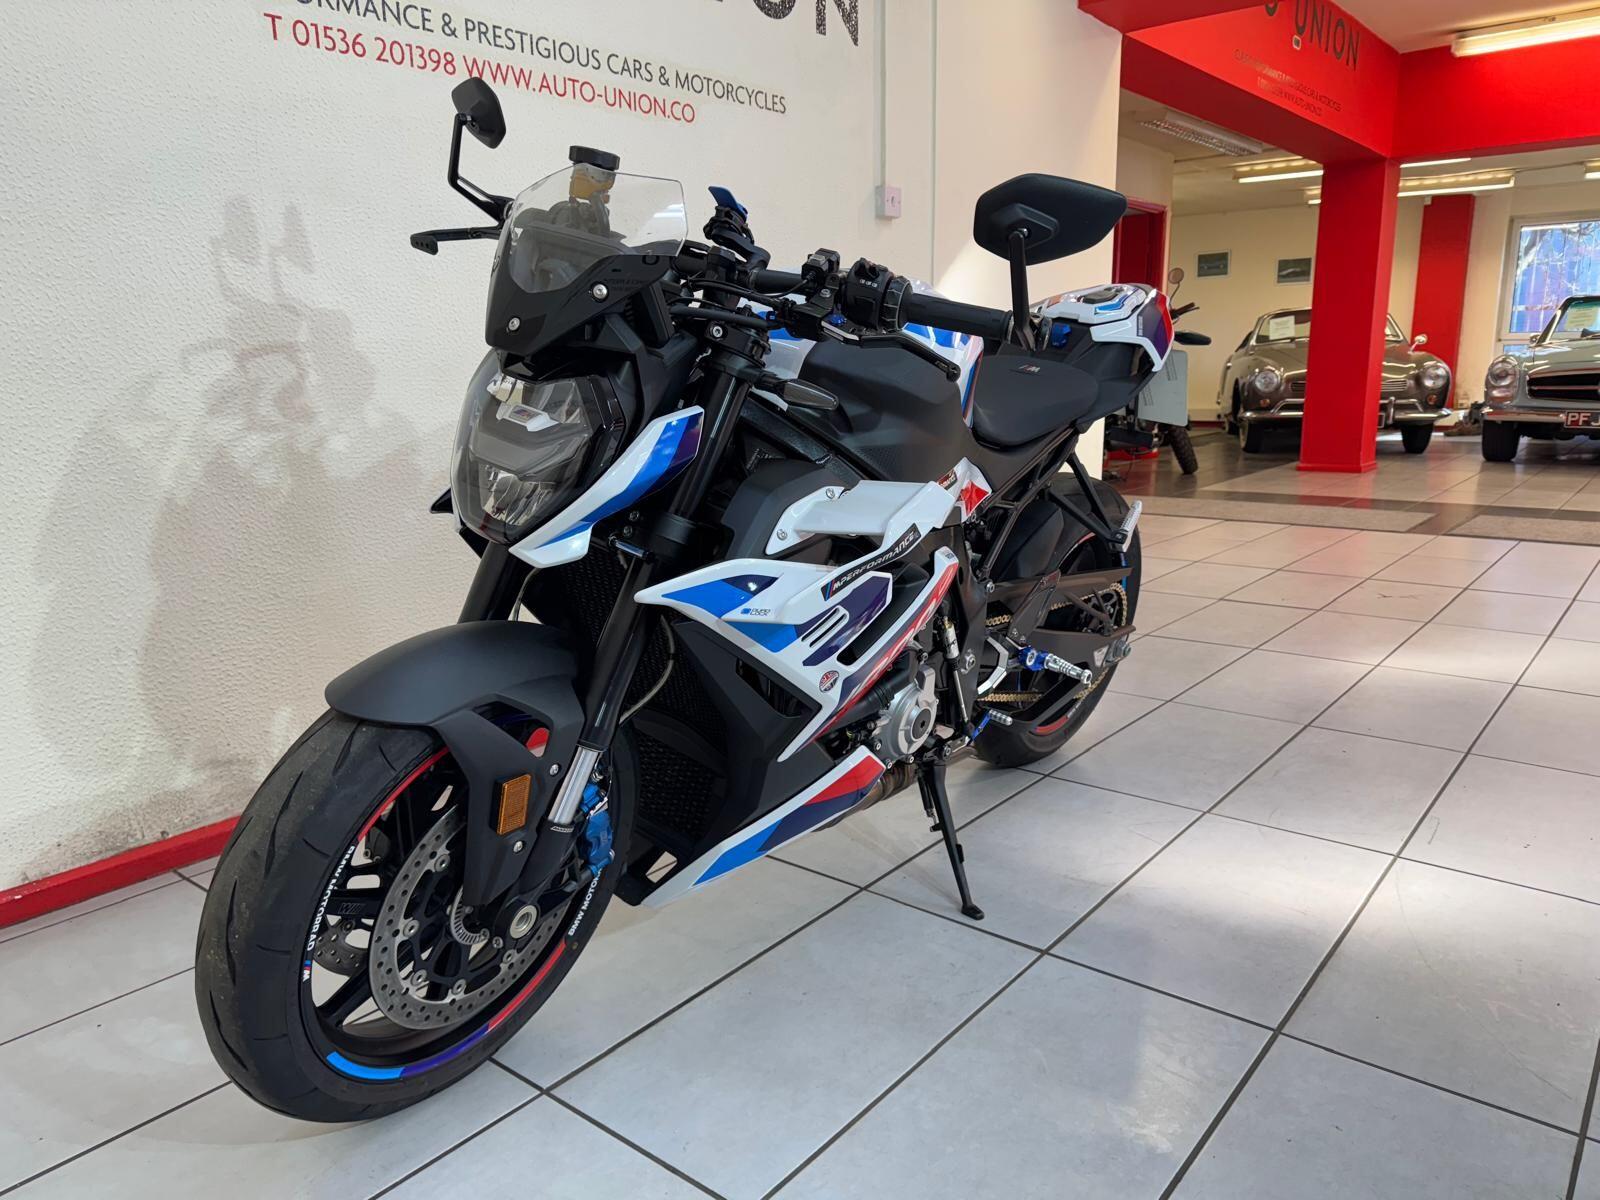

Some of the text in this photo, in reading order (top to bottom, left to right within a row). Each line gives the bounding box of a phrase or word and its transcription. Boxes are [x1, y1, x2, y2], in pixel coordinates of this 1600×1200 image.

[263, 12, 695, 123] T 01536 201398 WWW.AUTO-UNION.CO
[441, 12, 459, 38] &
[464, 17, 601, 70] PRESTIGIOUS
[606, 53, 653, 82] CARS
[658, 65, 670, 87] &
[675, 70, 786, 115] MOTORCYCLES
[1295, 0, 1359, 72] UNION
